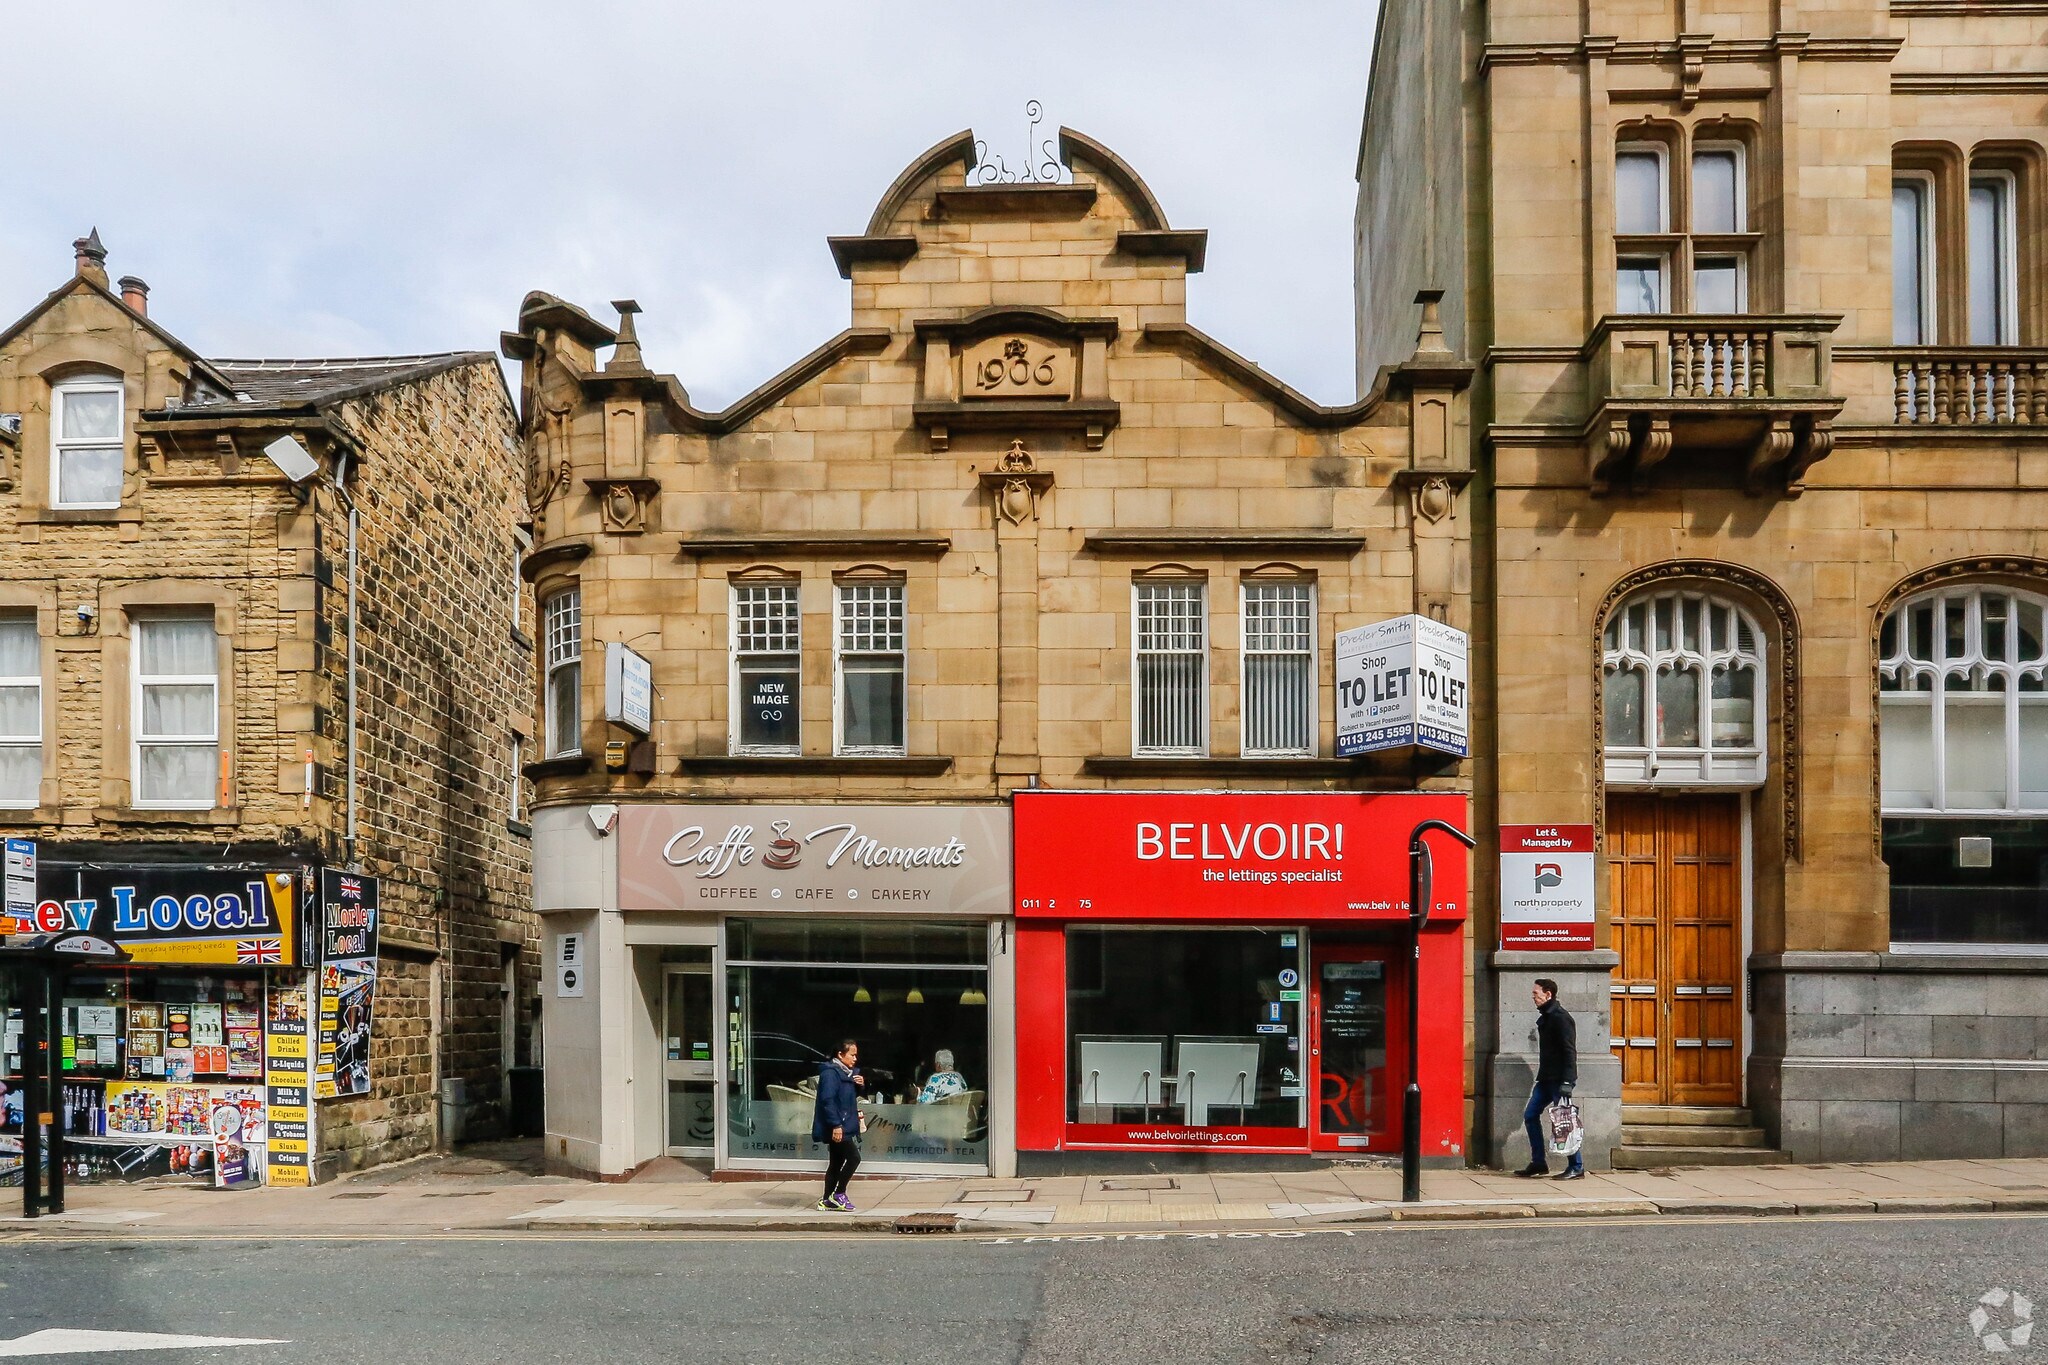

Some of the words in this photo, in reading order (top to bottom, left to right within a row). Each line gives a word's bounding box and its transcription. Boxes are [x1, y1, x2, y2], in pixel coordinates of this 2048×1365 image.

[976, 354, 1056, 390] 1906
[1362, 656, 1386, 670] Shop
[1434, 654, 1451, 672] Shop
[760, 684, 784, 693] NEW
[1340, 677, 1366, 708] TO
[1374, 667, 1411, 702] LET
[1419, 668, 1437, 700] TO
[1442, 676, 1465, 709] LET
[752, 696, 790, 704] IMAGE
[1350, 710, 1364, 719] with
[1380, 704, 1400, 714] space
[1426, 703, 1436, 712] with
[1446, 708, 1459, 720] space
[1365, 719, 1381, 727] Vacant
[1340, 734, 1363, 747] 0113
[1366, 730, 1384, 742] 245
[1386, 725, 1412, 738] 5599
[1418, 726, 1436, 738] 0113
[1437, 729, 1449, 742] 245
[1450, 732, 1466, 747] 5599
[1135, 822, 1344, 861] BELVOIR!
[1522, 839, 1560, 848] Managed
[1561, 839, 1572, 847] by
[663, 824, 756, 878] Caffe
[804, 824, 966, 870] Moments
[1203, 868, 1225, 881] the
[1228, 868, 1277, 884] lettings
[1280, 869, 1343, 885] specialist
[700, 887, 757, 899] COFFEE
[795, 888, 834, 899] CAFE
[872, 889, 931, 900] CAKERY
[112, 881, 269, 932] Local
[326, 903, 374, 932] Morley
[168, 943, 202, 954] shopping
[328, 929, 365, 954] Local
[289, 1024, 304, 1033] Toys
[272, 1060, 304, 1069] E-Liquids
[277, 1097, 300, 1105] Breads
[273, 1110, 304, 1119] E-Cigarettes
[1128, 1130, 1247, 1142] www.belvoirlettings.com
[278, 1154, 300, 1163] Crisps
